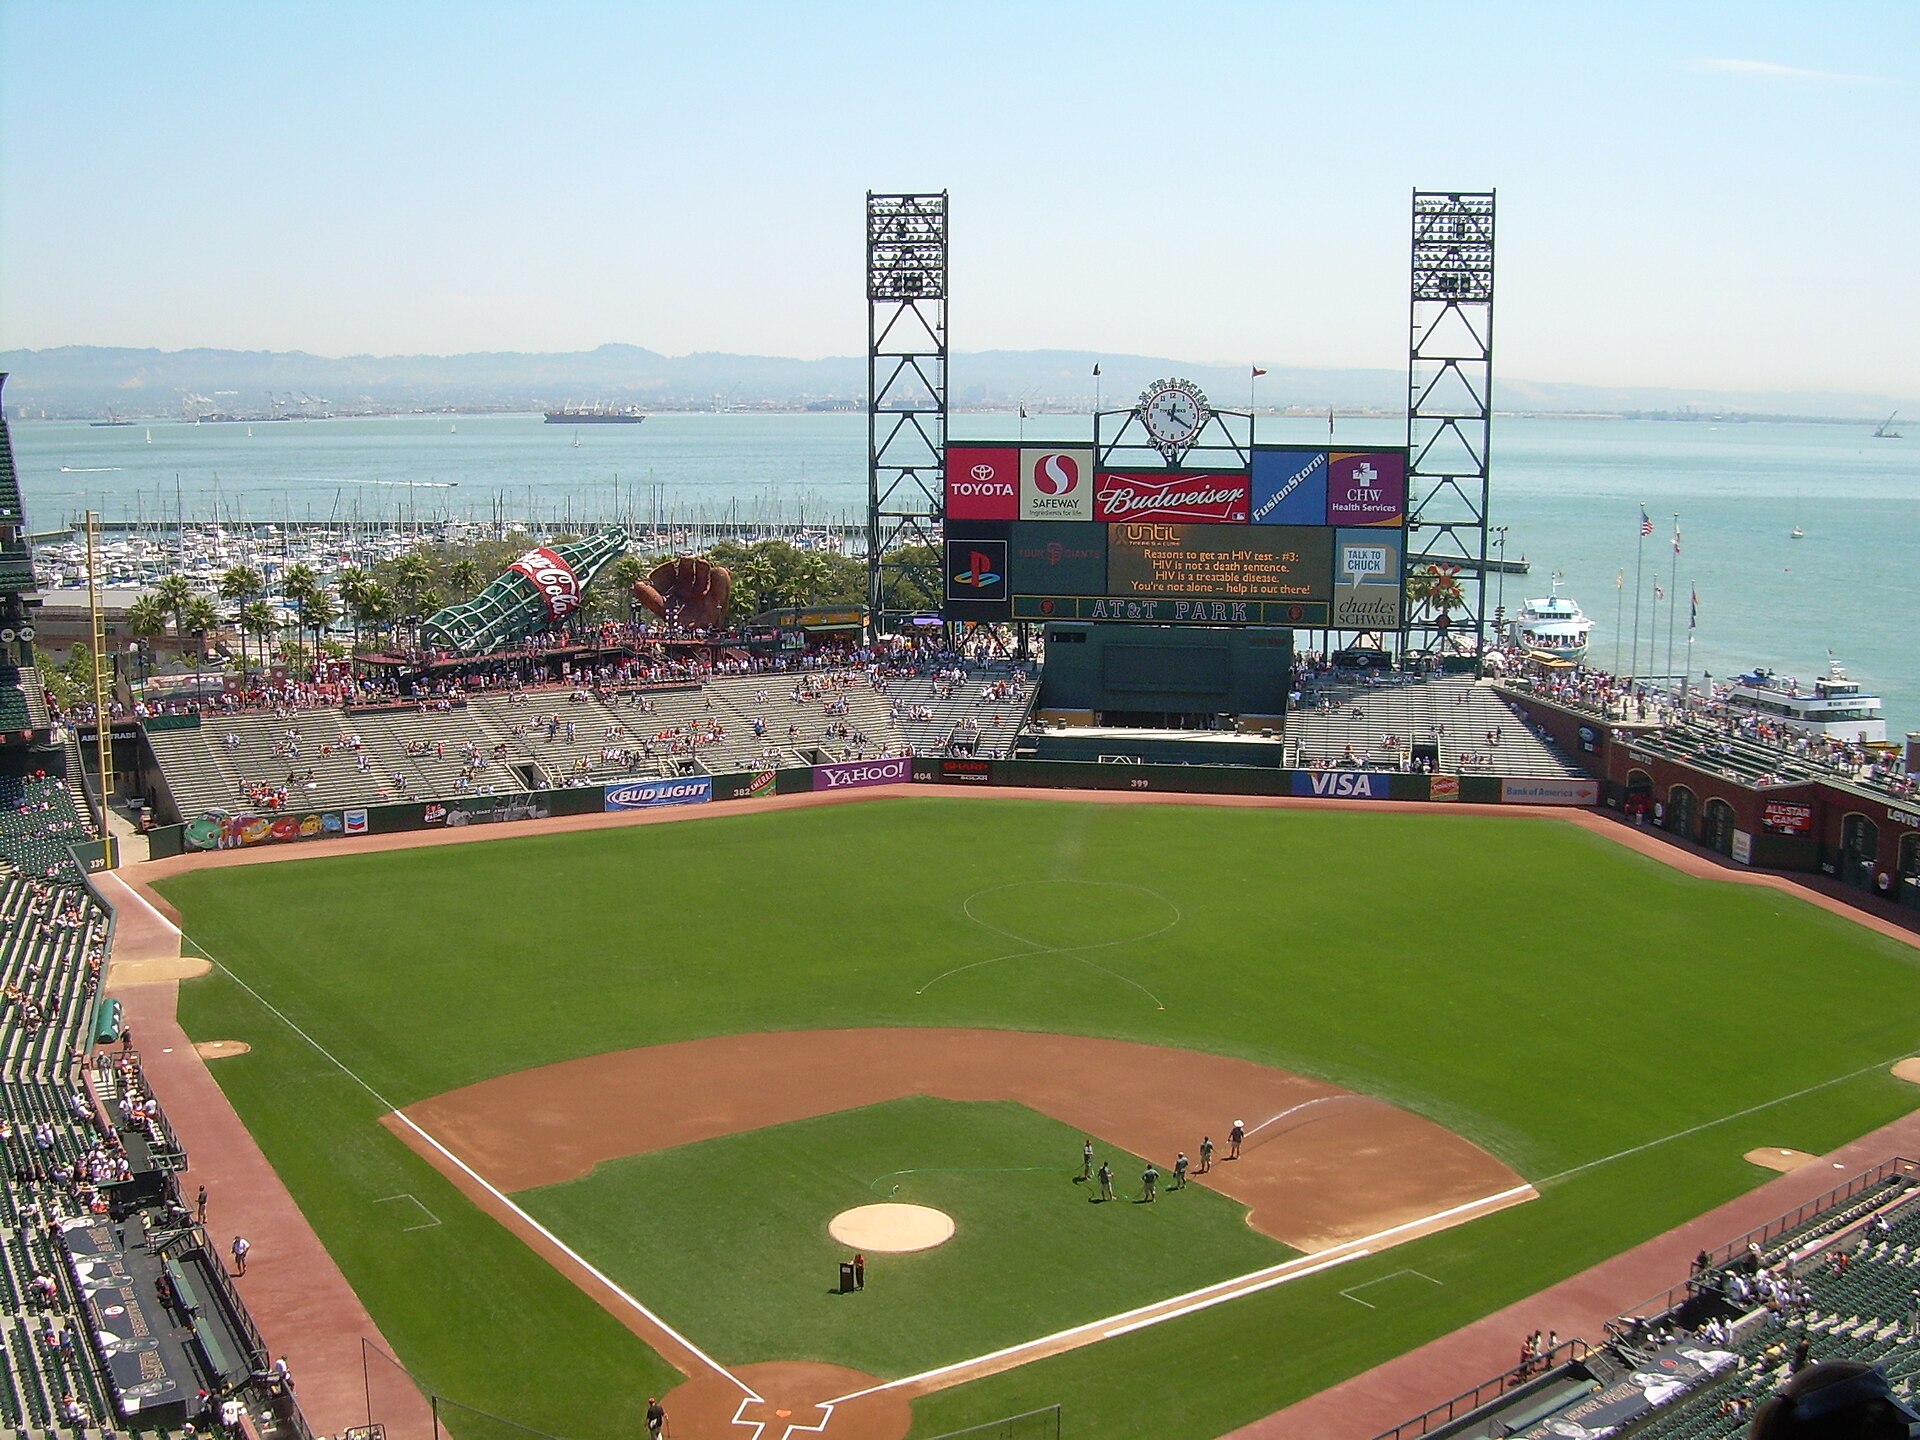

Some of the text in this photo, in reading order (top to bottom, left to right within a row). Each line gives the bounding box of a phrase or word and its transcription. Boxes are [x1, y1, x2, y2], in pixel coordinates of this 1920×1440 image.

[1149, 377, 1212, 421] FRANCISCO
[951, 483, 1014, 496] TOYOTA
[1253, 453, 1325, 522] FusionStorm
[1097, 484, 1245, 515] Budweiser
[1347, 489, 1383, 502] CHW
[1033, 498, 1080, 509] SAFEWAY
[1332, 503, 1397, 513] Health Services
[1144, 549, 1184, 560] Reasons
[1185, 551, 1196, 560] to
[1199, 551, 1215, 562] get
[1217, 552, 1230, 561] an
[1232, 551, 1252, 561] HIV
[1254, 552, 1273, 561] test
[1282, 552, 1300, 562] #3:
[1347, 550, 1381, 560] TALK TO
[1152, 559, 1172, 570] HIV
[1174, 560, 1182, 570] is
[1185, 561, 1202, 570] not
[1213, 560, 1240, 571] death
[1243, 562, 1290, 573] sentence.
[1347, 561, 1381, 571] CHUCK
[1155, 570, 1175, 580] HIV
[1177, 571, 1185, 580] is
[1196, 571, 1240, 582] treatable
[1242, 573, 1280, 583] disease.
[1131, 580, 1164, 591] You're
[1167, 582, 1184, 592] not
[1186, 582, 1212, 592] alone
[1226, 583, 1248, 596] help
[1250, 584, 1258, 594] is
[1261, 585, 1278, 594] out
[1280, 584, 1311, 595] there!
[1092, 599, 1248, 621] AT&T PARK
[1339, 597, 1396, 614] charles
[1339, 614, 1396, 626] SCHWAB
[943, 762, 988, 771] SHARP
[750, 770, 776, 791] EMERALD
[820, 762, 905, 787] YAHOO!
[913, 772, 932, 781] 404
[1130, 779, 1150, 788] 399
[1311, 772, 1372, 797] VISA
[619, 783, 709, 802] BUD LIGHT
[733, 789, 751, 797] 382
[1506, 786, 1573, 798] Bank of America
[1765, 804, 1811, 817] ALL-STAR
[1772, 814, 1803, 826] GAME
[89, 858, 105, 869] 339
